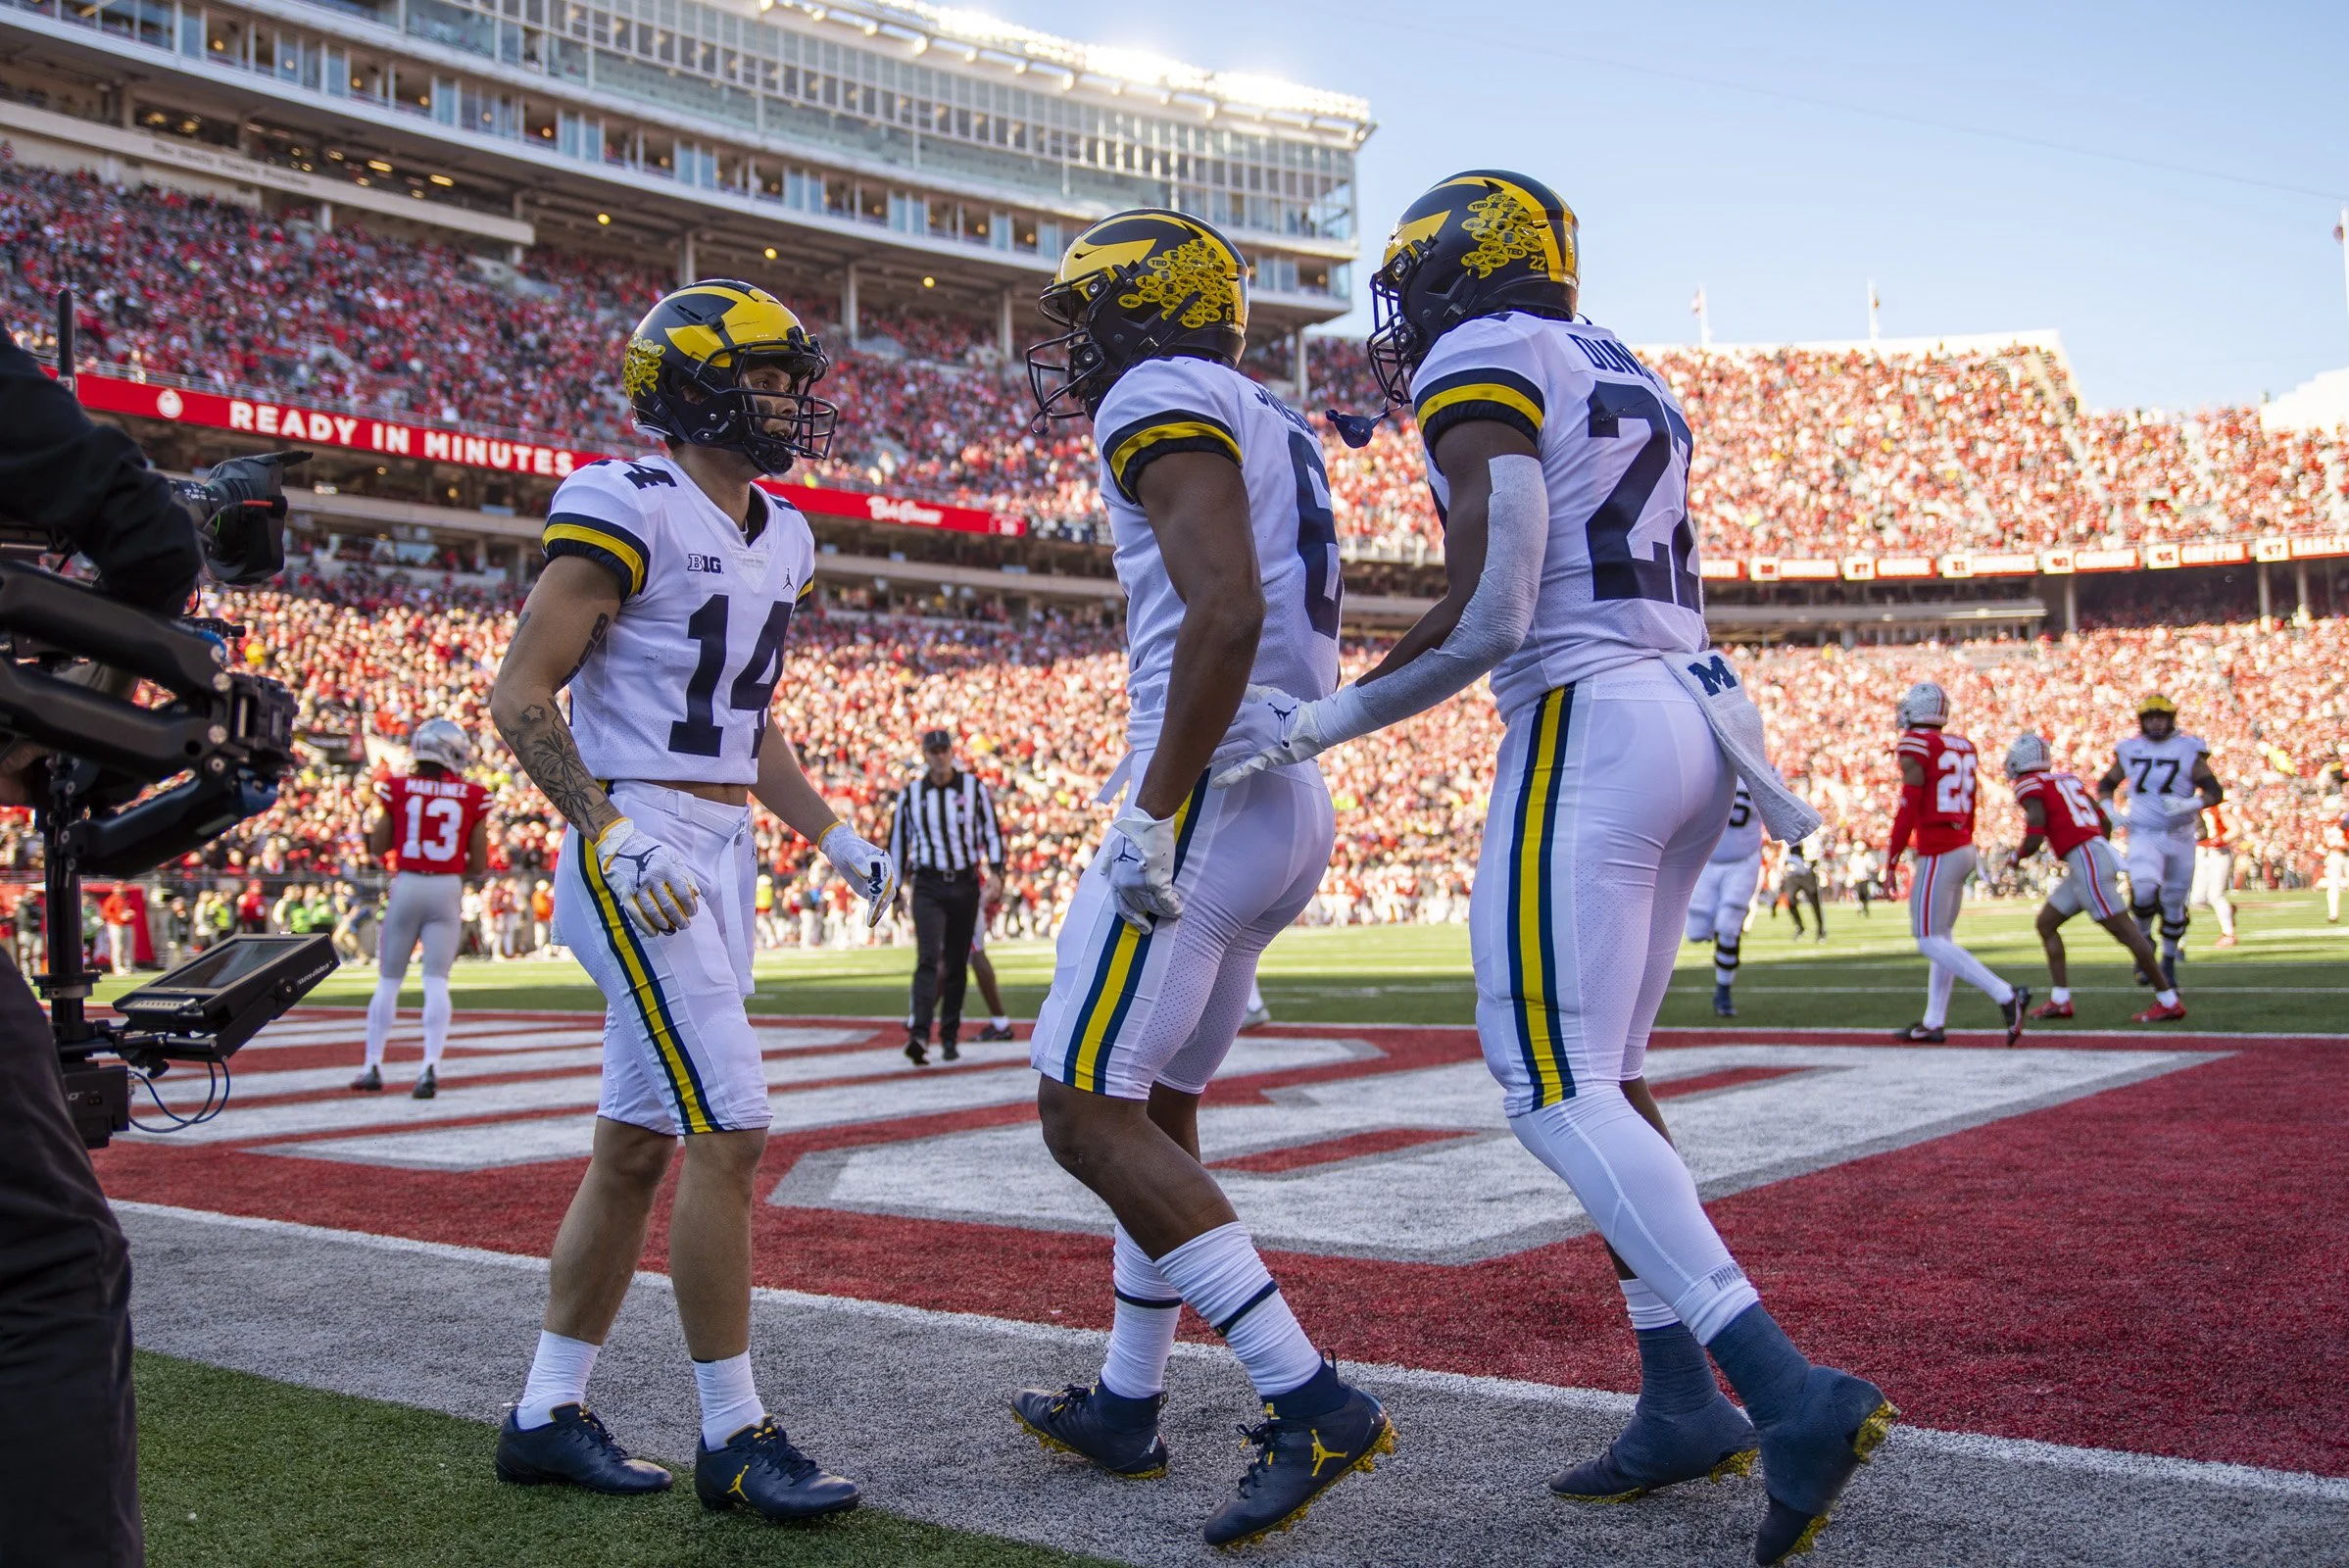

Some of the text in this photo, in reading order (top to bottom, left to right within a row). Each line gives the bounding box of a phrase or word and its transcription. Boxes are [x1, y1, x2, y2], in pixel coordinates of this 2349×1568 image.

[1529, 255, 1545, 271] 22
[229, 400, 575, 478] READY IN MINUTES
[668, 594, 793, 760] 14
[1687, 655, 1737, 697] M
[2055, 776, 2100, 827] 15
[2129, 758, 2179, 794] 77
[402, 794, 464, 862] 13
